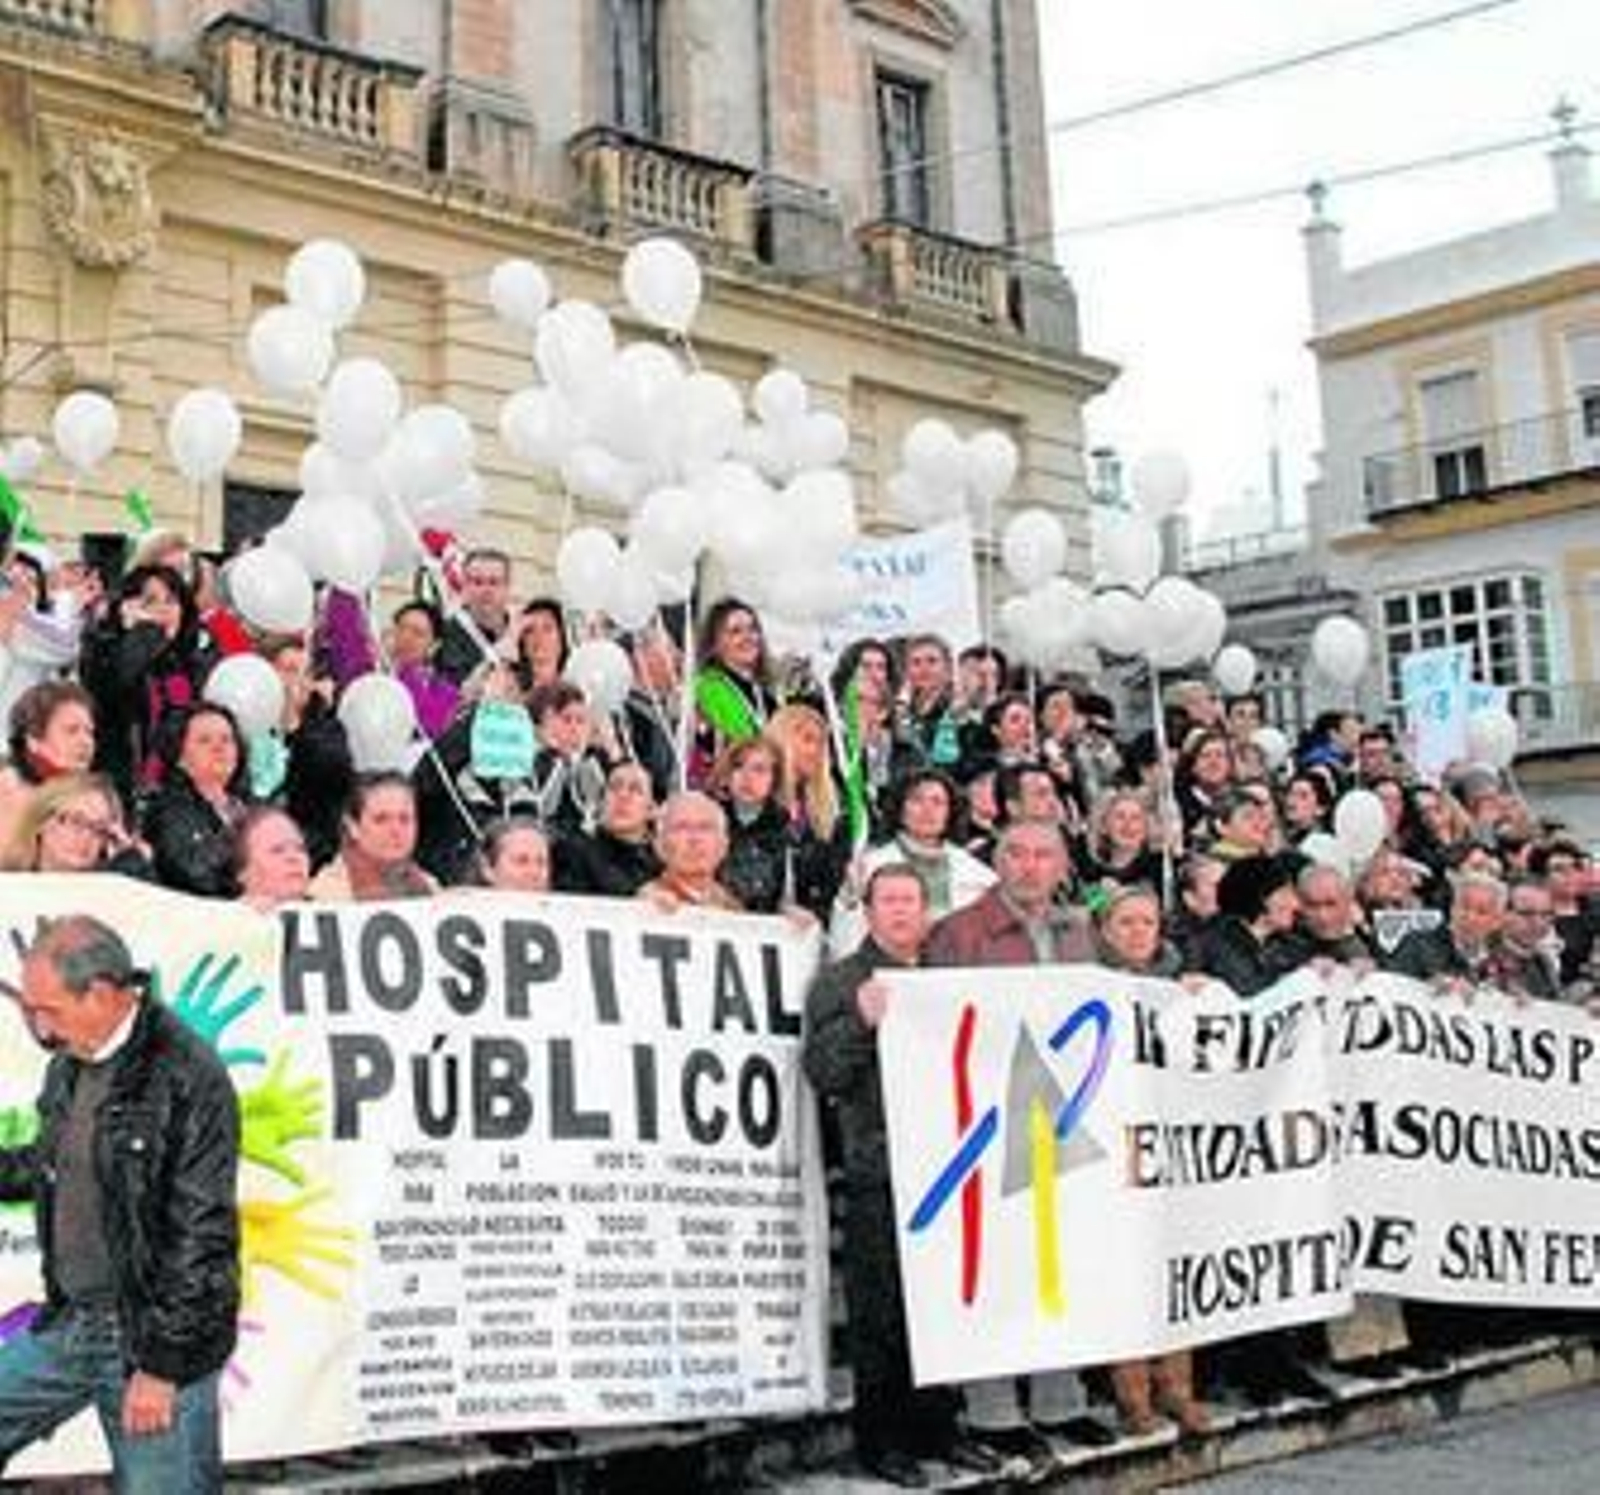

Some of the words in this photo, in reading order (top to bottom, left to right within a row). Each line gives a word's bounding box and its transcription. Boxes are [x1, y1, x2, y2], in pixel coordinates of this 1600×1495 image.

[279, 909, 802, 1037] HOSPITAL
[328, 1033, 780, 1149] PÚBLICO
[1484, 1022, 1556, 1083] LAS
[1350, 1099, 1600, 1180] ASOCIADAS
[1167, 1230, 1345, 1324] HOSPIT
[1440, 1222, 1529, 1284] SAN
